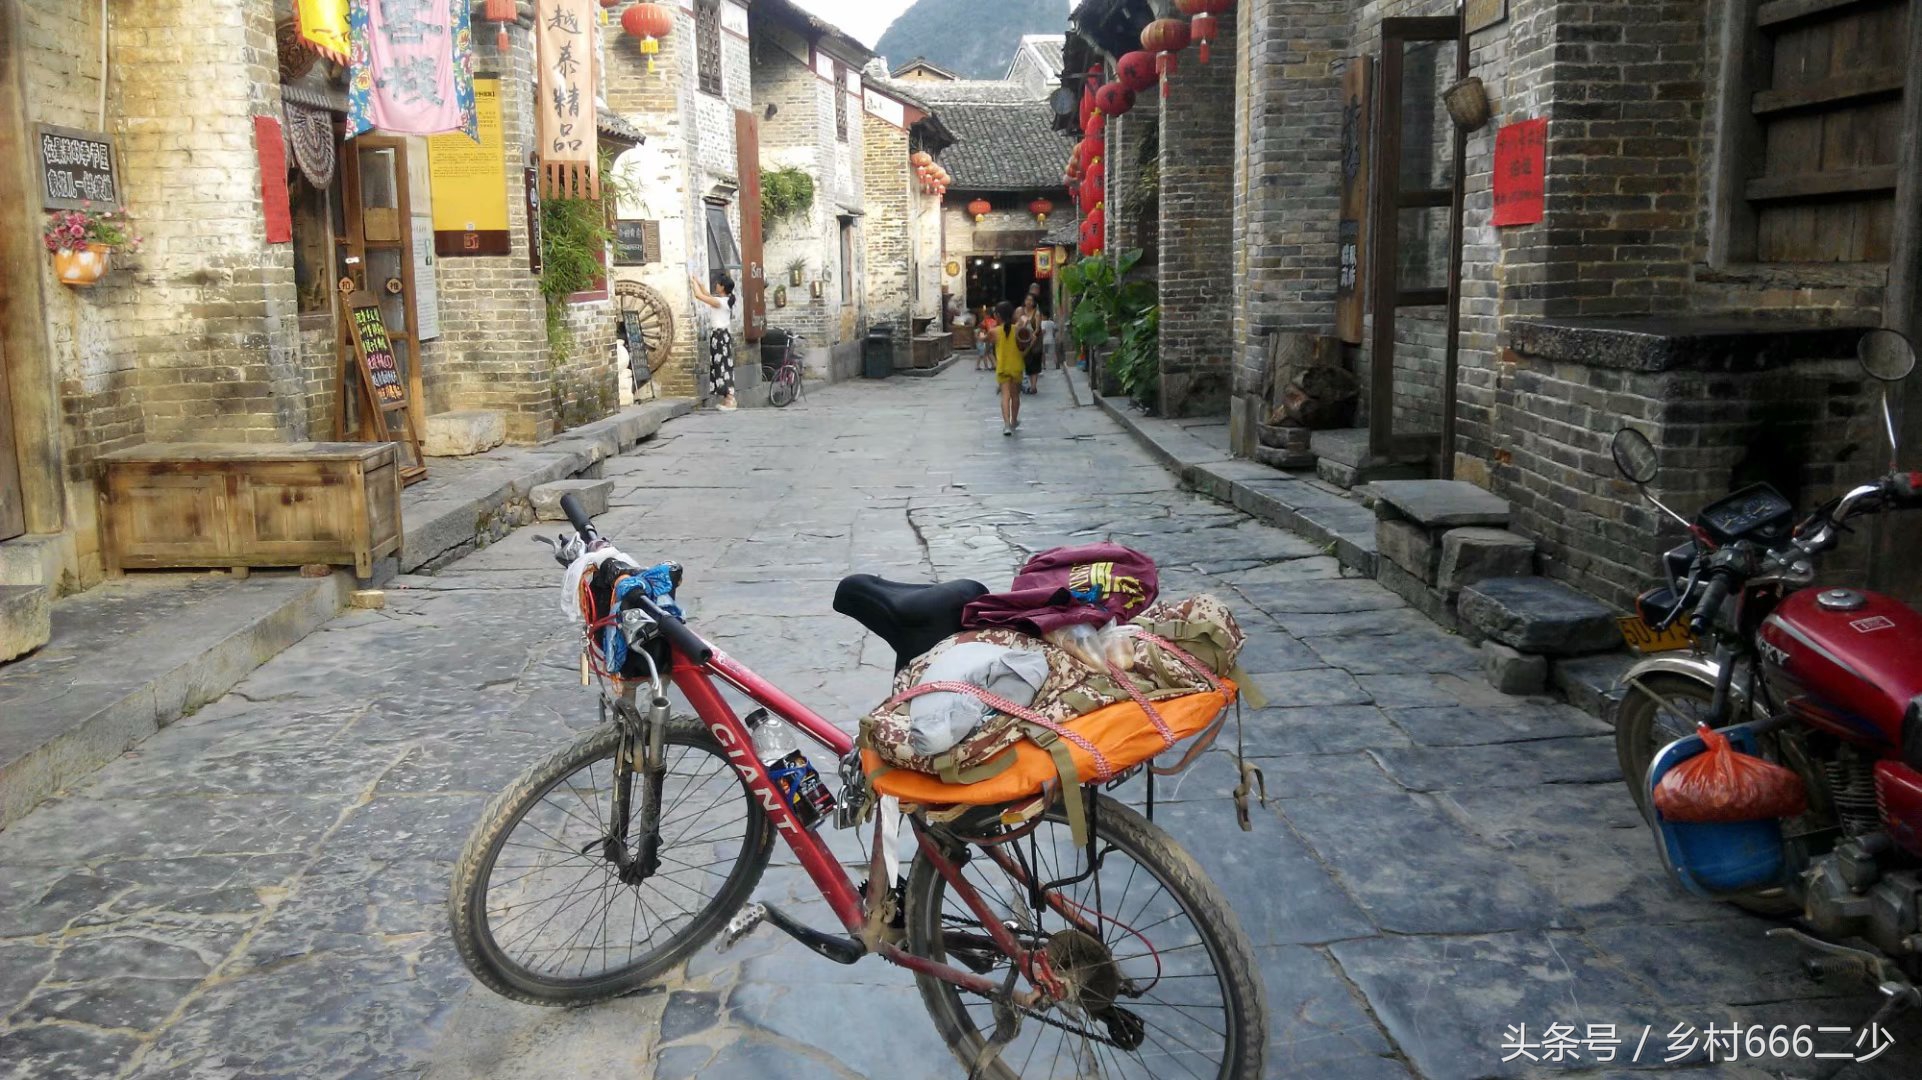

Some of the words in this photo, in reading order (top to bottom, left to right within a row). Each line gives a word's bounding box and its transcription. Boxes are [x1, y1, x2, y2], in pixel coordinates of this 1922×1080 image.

[547, 4, 583, 153] 越泰精品
[711, 723, 798, 833] GIANT
